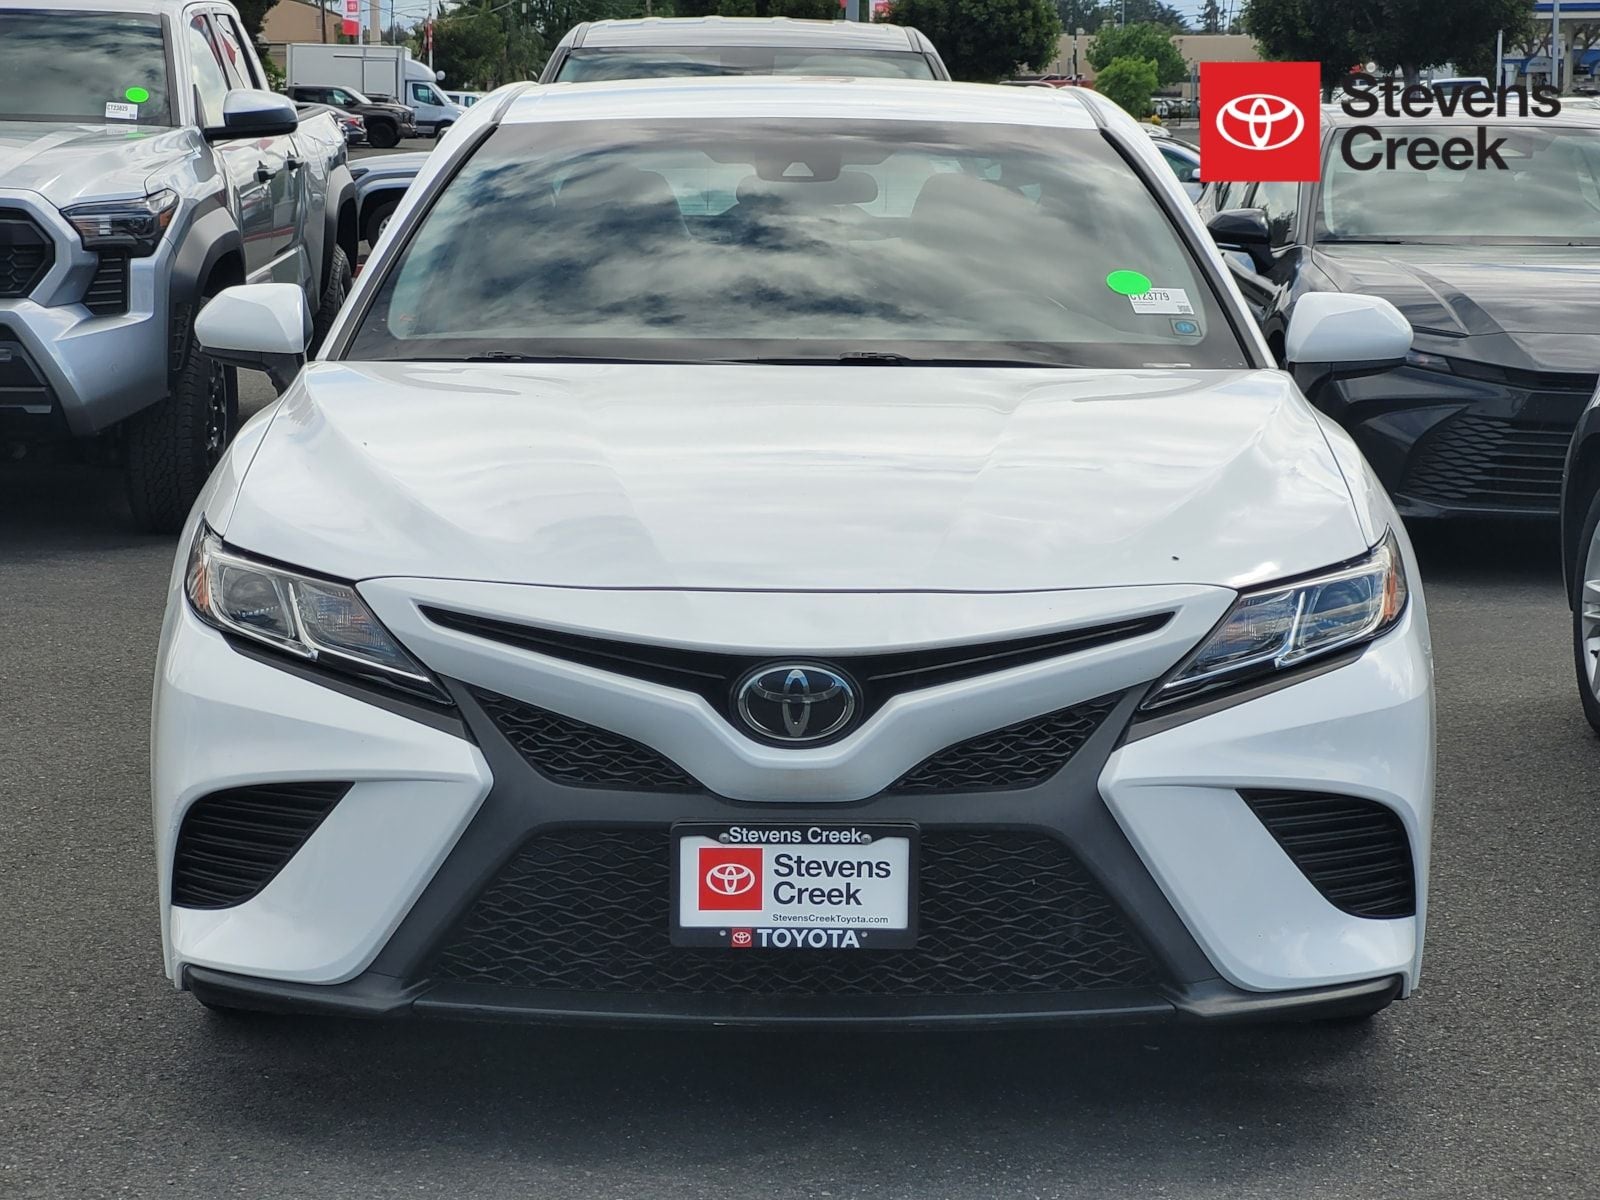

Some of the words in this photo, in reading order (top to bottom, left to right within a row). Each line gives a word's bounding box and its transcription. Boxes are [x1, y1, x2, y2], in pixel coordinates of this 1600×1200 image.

[729, 826, 802, 843] Stevens
[807, 826, 862, 843] Creek
[773, 853, 891, 879] Stevens
[773, 881, 863, 906] Creek
[772, 913, 889, 924] StevensCreekToyota.com
[756, 928, 860, 949] TOYOTA
